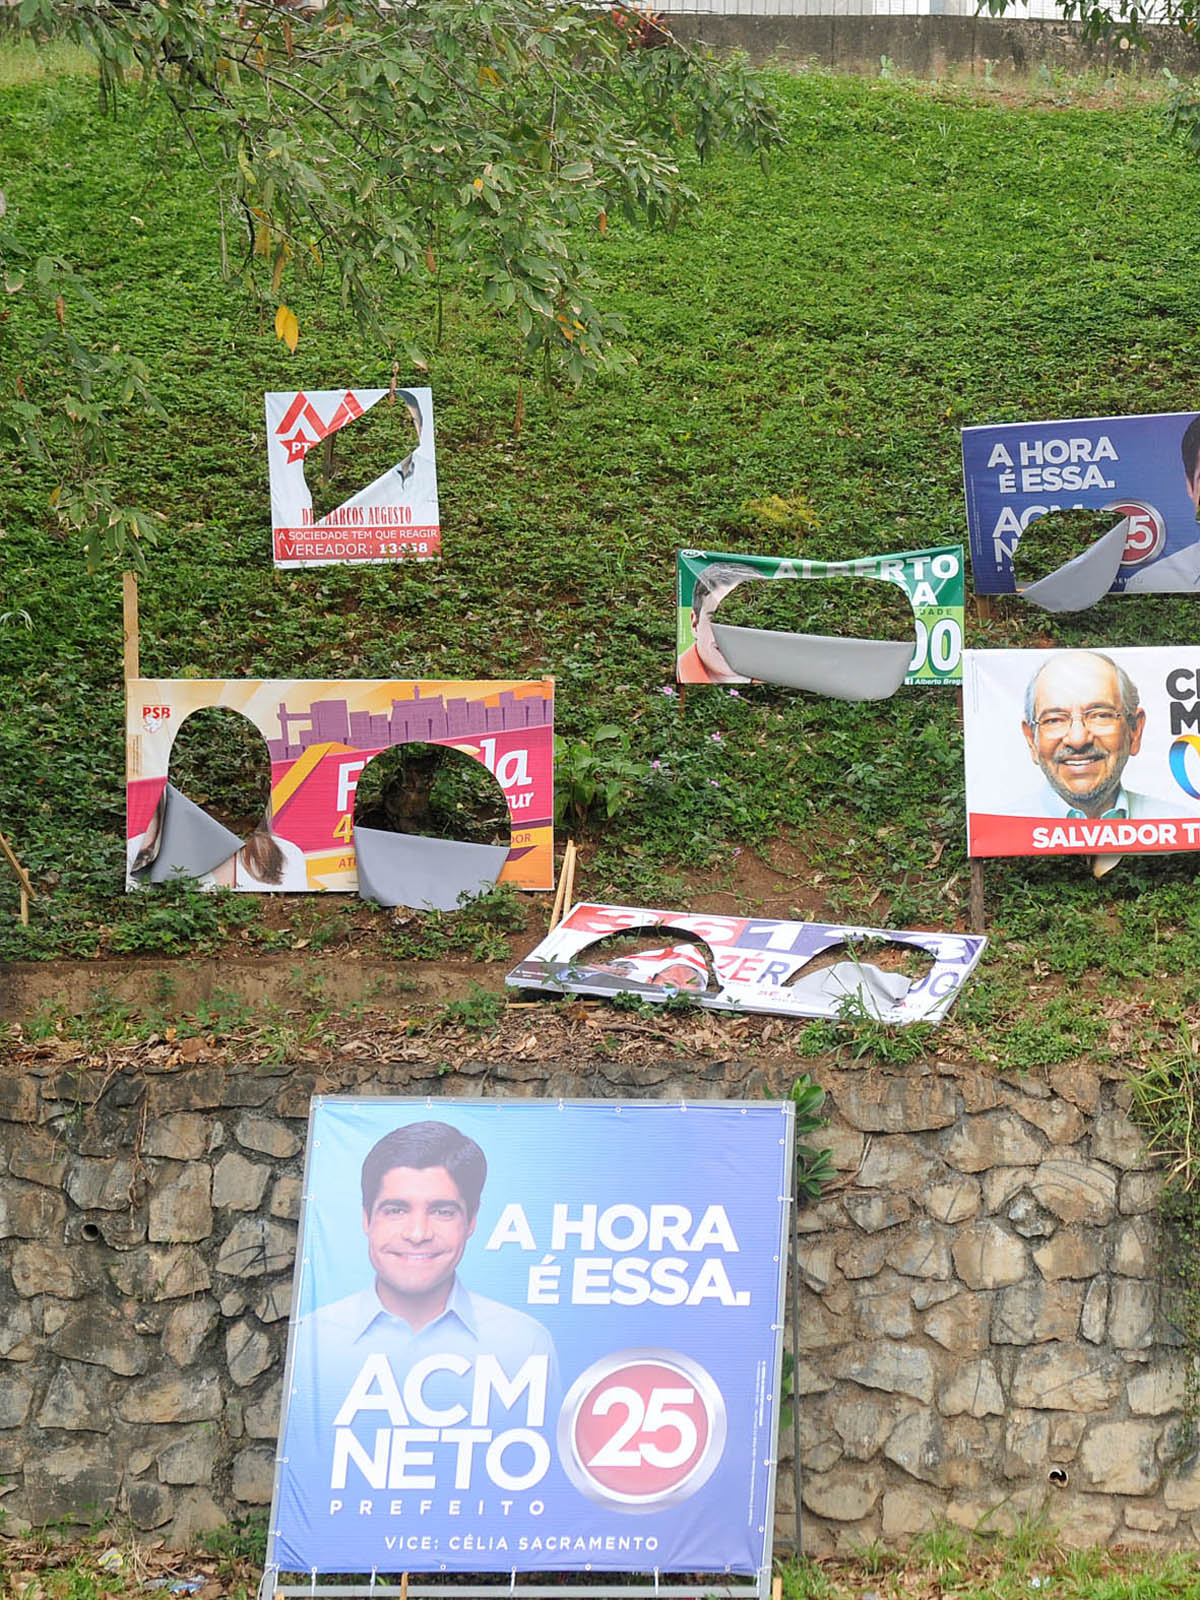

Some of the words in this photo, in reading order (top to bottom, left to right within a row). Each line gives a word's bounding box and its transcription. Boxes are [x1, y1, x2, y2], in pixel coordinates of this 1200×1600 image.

[291, 442, 311, 455] PT
[988, 444, 1014, 467] A
[1020, 437, 1118, 466] HORA
[1000, 469, 1016, 493] É
[1023, 466, 1115, 491] ESSA.
[368, 506, 412, 525] AUGUSTO
[278, 533, 286, 541] A
[289, 531, 348, 541] SOCIEDADE
[352, 530, 372, 540] TEM
[375, 530, 397, 541] QUE
[400, 529, 438, 539] REAGIR
[285, 543, 374, 556] VEREADOR:
[143, 705, 170, 719] PSB
[1032, 825, 1177, 848] SALVADOR
[485, 1204, 536, 1251] A
[551, 1204, 739, 1252] HORA
[527, 1256, 561, 1304] É
[571, 1257, 750, 1306] ESSA.
[333, 1353, 549, 1428] ACM
[587, 1386, 698, 1468] 25
[330, 1428, 551, 1491] NETO
[330, 1500, 545, 1516] PREFEITO
[384, 1537, 440, 1551] VICE:
[449, 1534, 507, 1552] CÉLIA
[518, 1536, 659, 1552] SACRAMENTO
